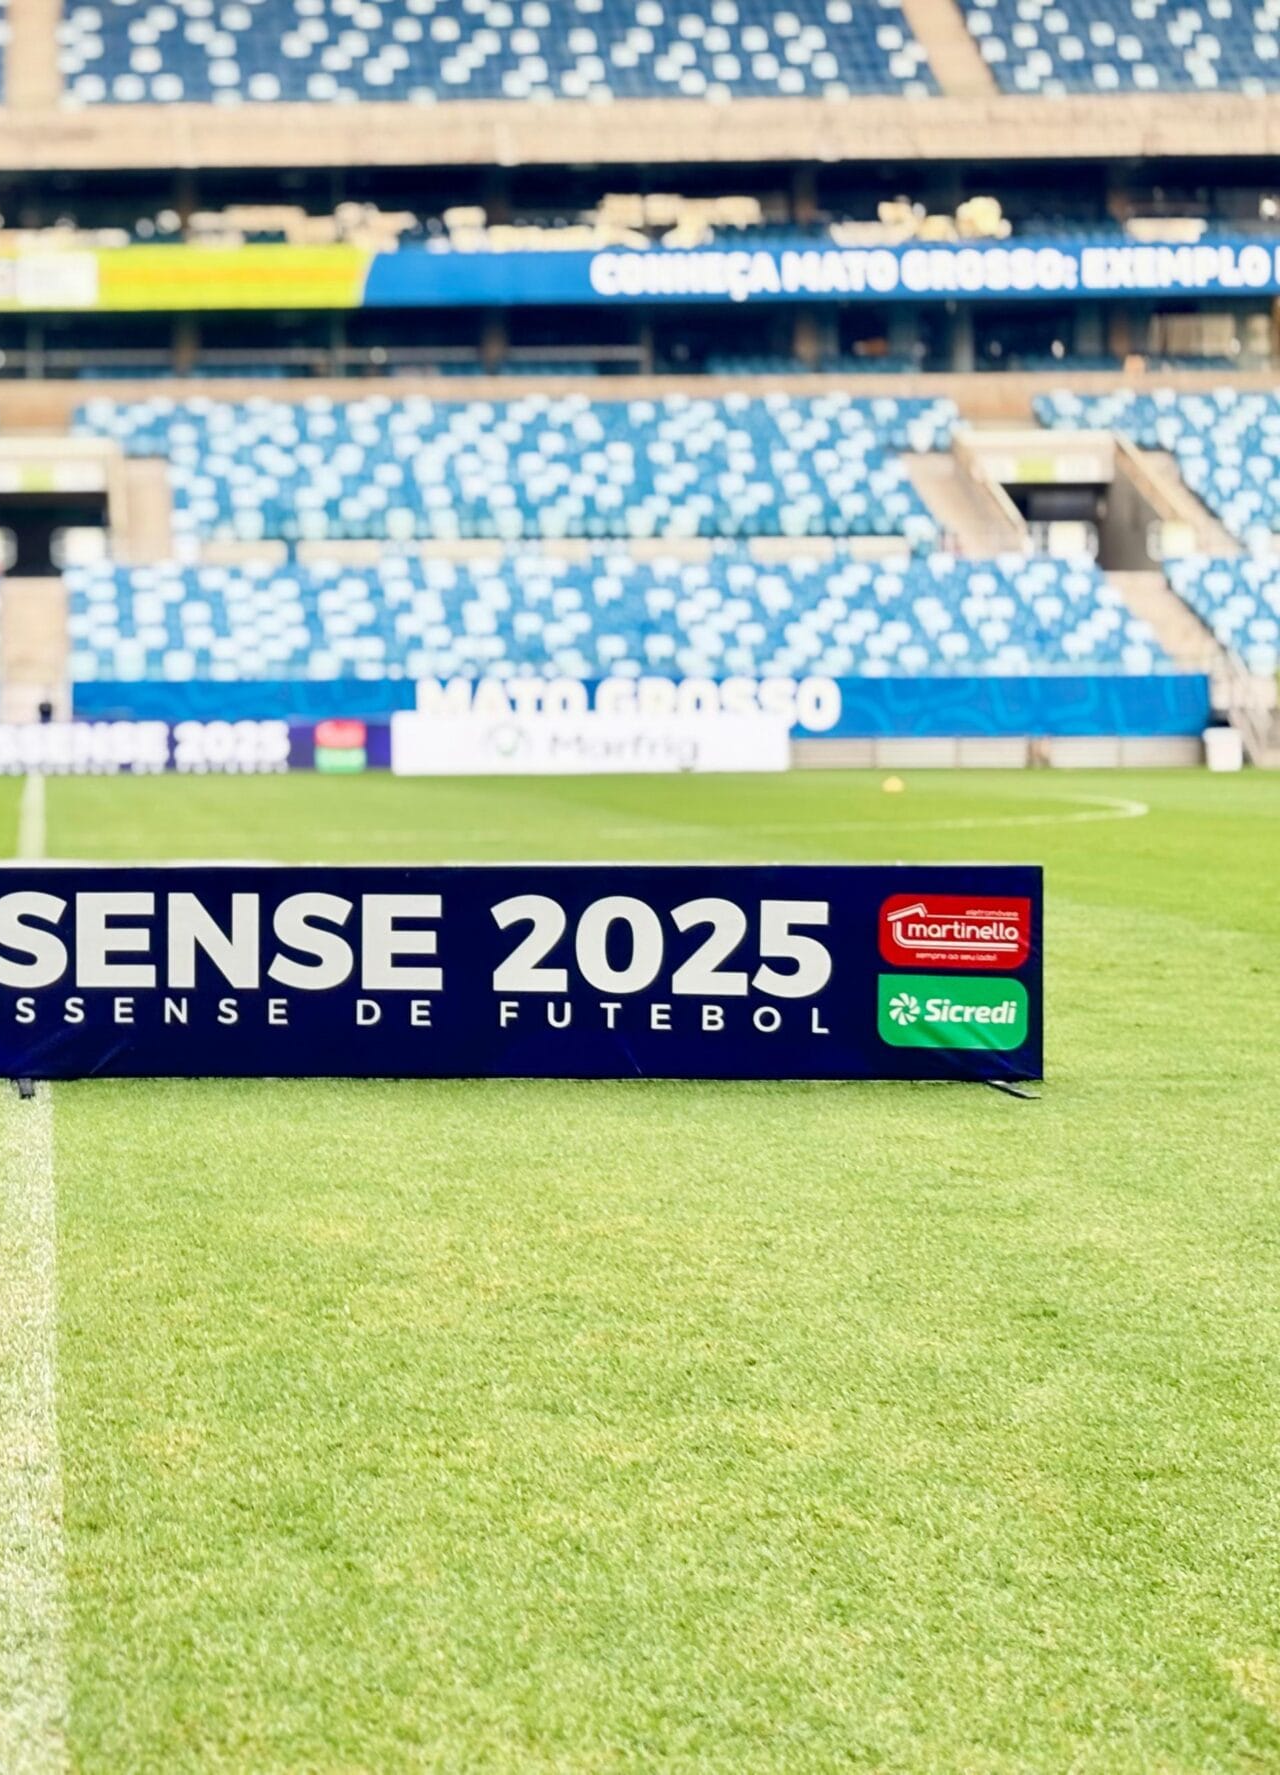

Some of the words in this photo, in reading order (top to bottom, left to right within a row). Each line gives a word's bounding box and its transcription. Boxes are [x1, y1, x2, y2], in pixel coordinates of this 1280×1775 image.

[590, 251, 781, 302] CONHEÇA
[781, 250, 899, 292] MATO
[901, 248, 1077, 291] GROSSO:
[1081, 246, 1270, 288] EXEMPLO
[416, 676, 588, 714] MATO
[595, 676, 841, 731] GROSSO
[173, 720, 290, 765] 2025
[549, 730, 700, 762] Marfrig
[491, 895, 831, 997] 2025
[908, 921, 1019, 940] martinello
[357, 999, 431, 1025] DE
[500, 1001, 829, 1033] FUTEBOL
[924, 998, 1017, 1024] Sicredi
